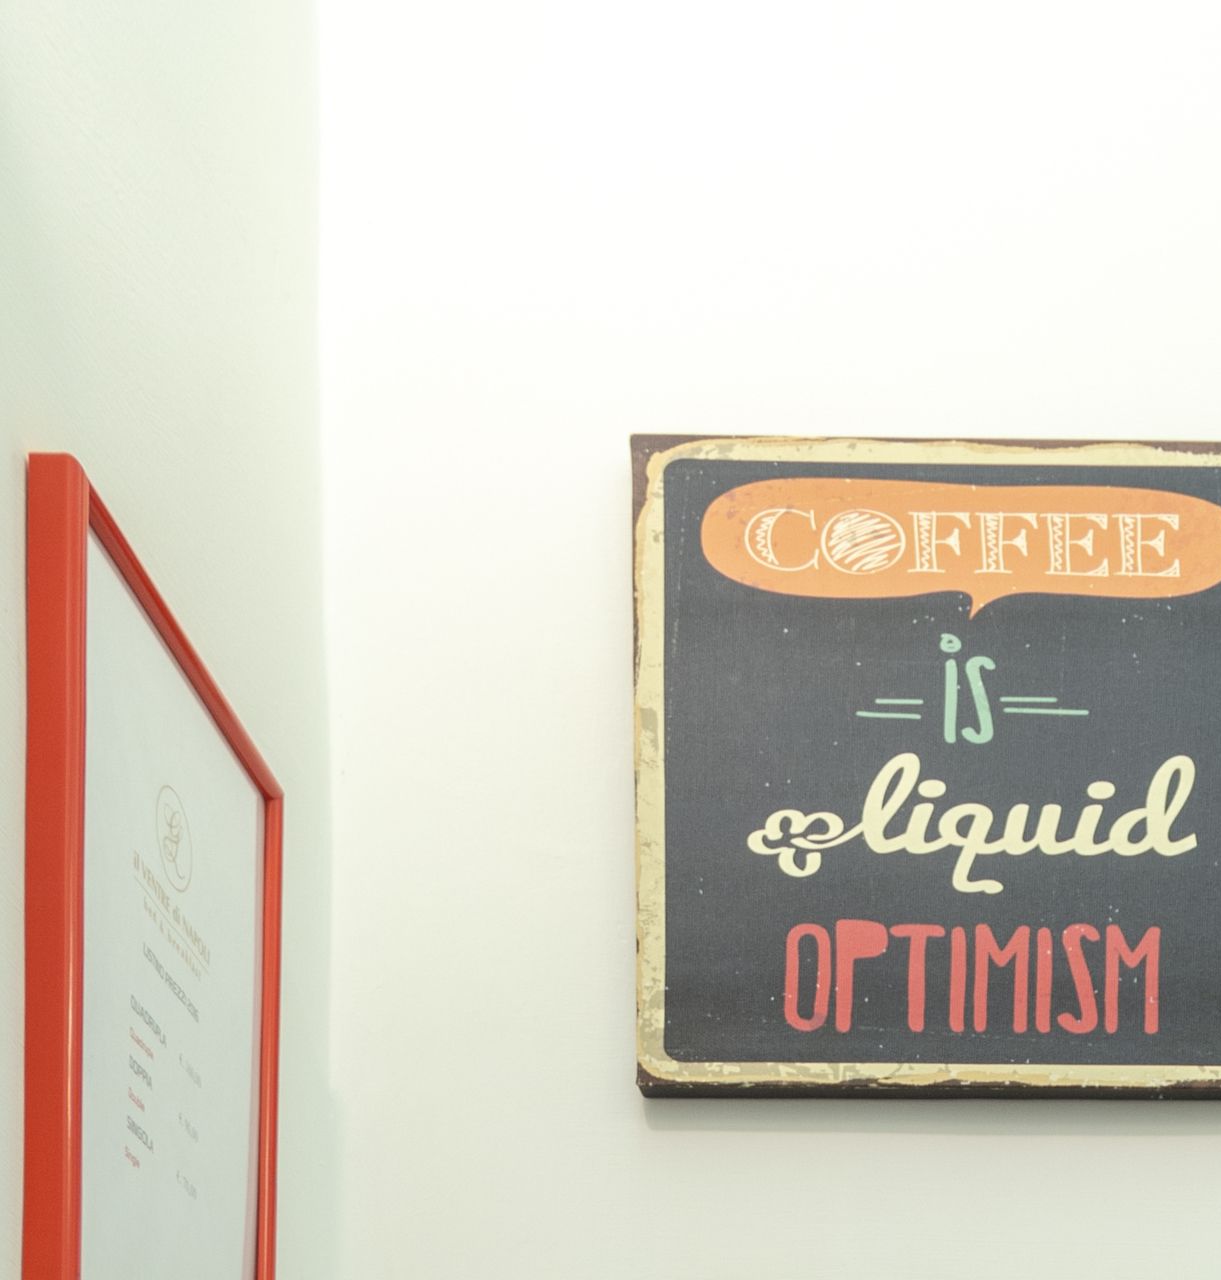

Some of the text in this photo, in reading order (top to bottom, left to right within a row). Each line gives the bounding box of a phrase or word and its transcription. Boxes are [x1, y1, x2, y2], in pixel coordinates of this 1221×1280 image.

[745, 508, 1181, 577] COFFEE
[748, 752, 1198, 893] liquid
[784, 919, 1161, 1034] OPTIMISM
